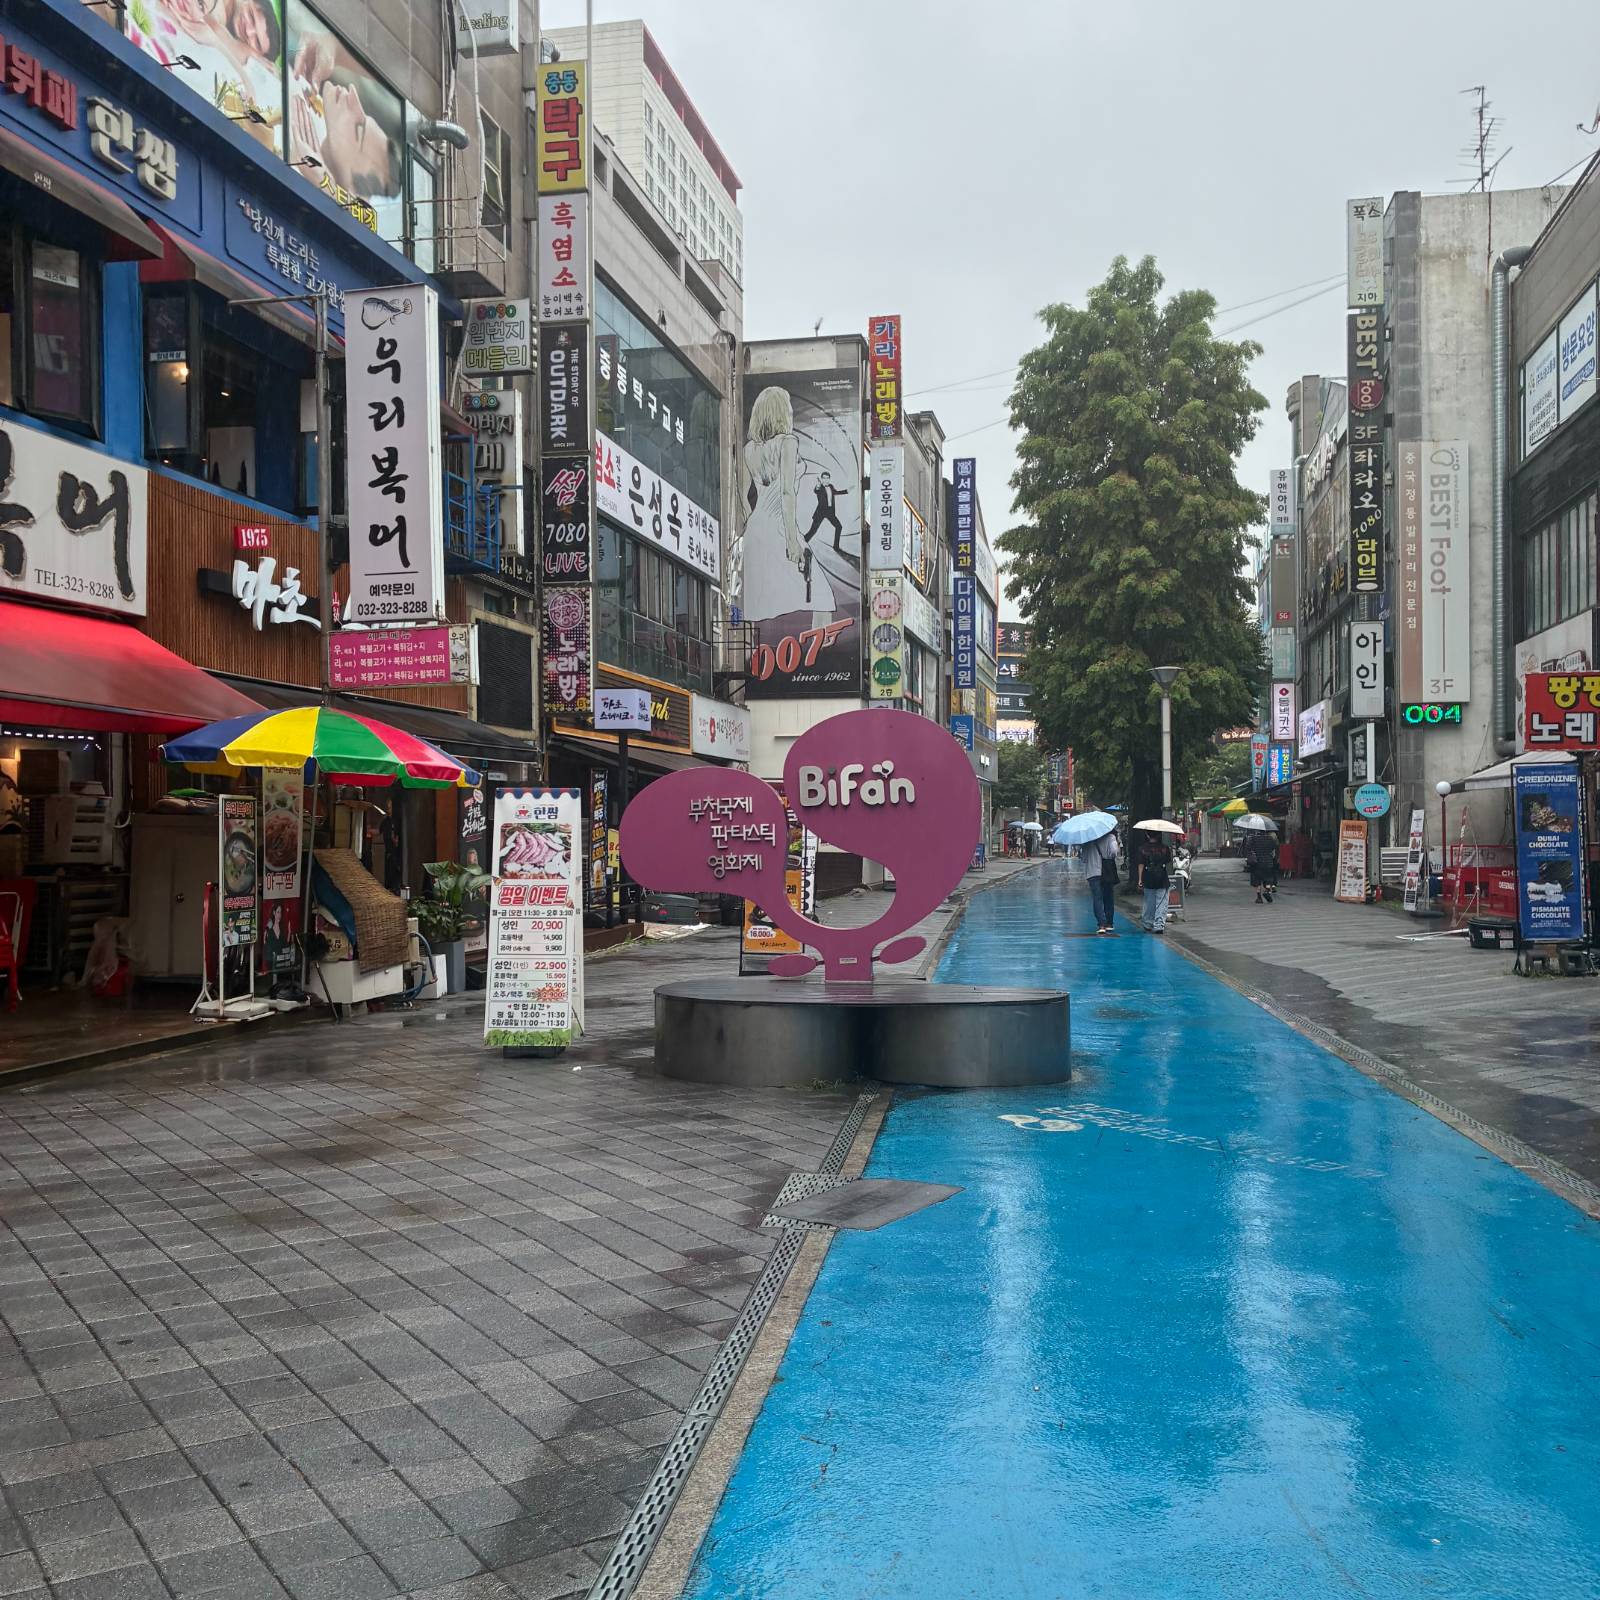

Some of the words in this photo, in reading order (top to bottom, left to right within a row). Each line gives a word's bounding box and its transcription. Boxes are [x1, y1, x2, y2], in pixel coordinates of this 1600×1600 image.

[460, 14, 509, 31] healing
[0, 33, 77, 130] 뷔페
[545, 70, 578, 94] 중동
[86, 95, 177, 200] 한쌈
[543, 97, 583, 181] 탁구
[1353, 203, 1381, 221] 폭스
[551, 202, 577, 286] 흑염소
[469, 320, 525, 346] 일번지
[874, 321, 896, 360] 카라
[1356, 315, 1378, 370] BEST
[465, 345, 527, 370] 메들리
[570, 348, 579, 364] THE
[570, 365, 579, 395] STORY
[875, 361, 897, 425] 노래방
[550, 350, 567, 440] OUTDARK
[570, 396, 579, 408] OF
[1354, 425, 1379, 440] 3F
[367, 337, 410, 568] 우리복어
[880, 479, 892, 518] 오후의
[1430, 473, 1452, 531] BEST
[241, 528, 268, 547] 1975
[545, 523, 586, 545] 7080
[881, 522, 892, 551] 힐링
[1352, 508, 1382, 541] 7080
[545, 551, 587, 574] LIVE
[1275, 543, 1290, 555] kt
[34, 567, 115, 601] TEL:323-8288
[369, 582, 415, 597] 예약문의
[357, 601, 428, 617] 032-323-8288
[556, 632, 580, 702] 노래방
[751, 627, 827, 682] 007
[791, 672, 820, 683] since
[822, 671, 852, 682] 1962
[1430, 678, 1454, 695] 3F
[1531, 713, 1600, 743] 노래
[533, 806, 559, 820] 한쌈
[688, 796, 753, 823] 부천국제
[711, 822, 776, 849] 판타스틱
[707, 852, 763, 879] 영화제
[500, 885, 527, 905] 평일
[529, 885, 568, 905] 이벤트
[501, 920, 518, 931] 성인
[531, 920, 563, 931] 20,900
[494, 961, 512, 970] 성인
